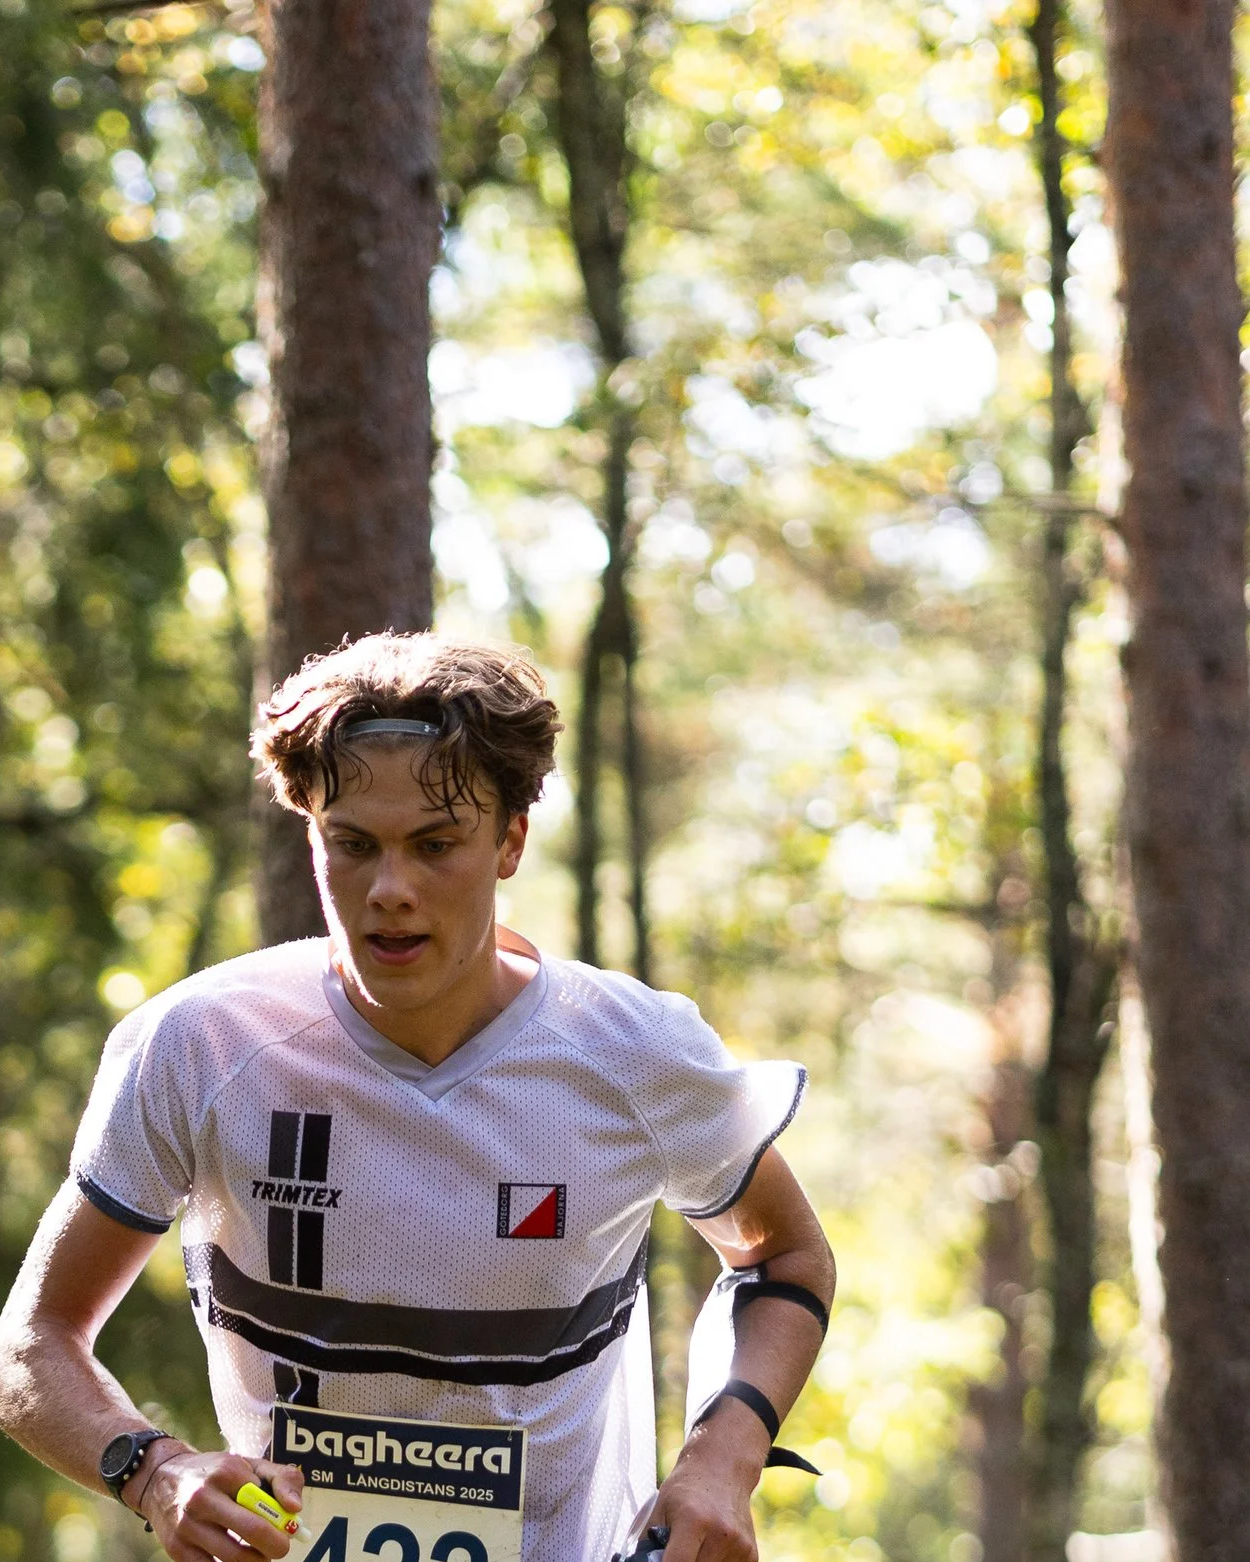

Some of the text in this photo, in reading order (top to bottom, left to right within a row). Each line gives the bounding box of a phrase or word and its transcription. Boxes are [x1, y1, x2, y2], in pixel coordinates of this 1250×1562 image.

[252, 1180, 343, 1208] TRIMTEX
[556, 1187, 565, 1237] MAJORNA
[286, 1420, 511, 1474] bagheera
[311, 1469, 494, 1501] SM LÅNGDISTANS 2025
